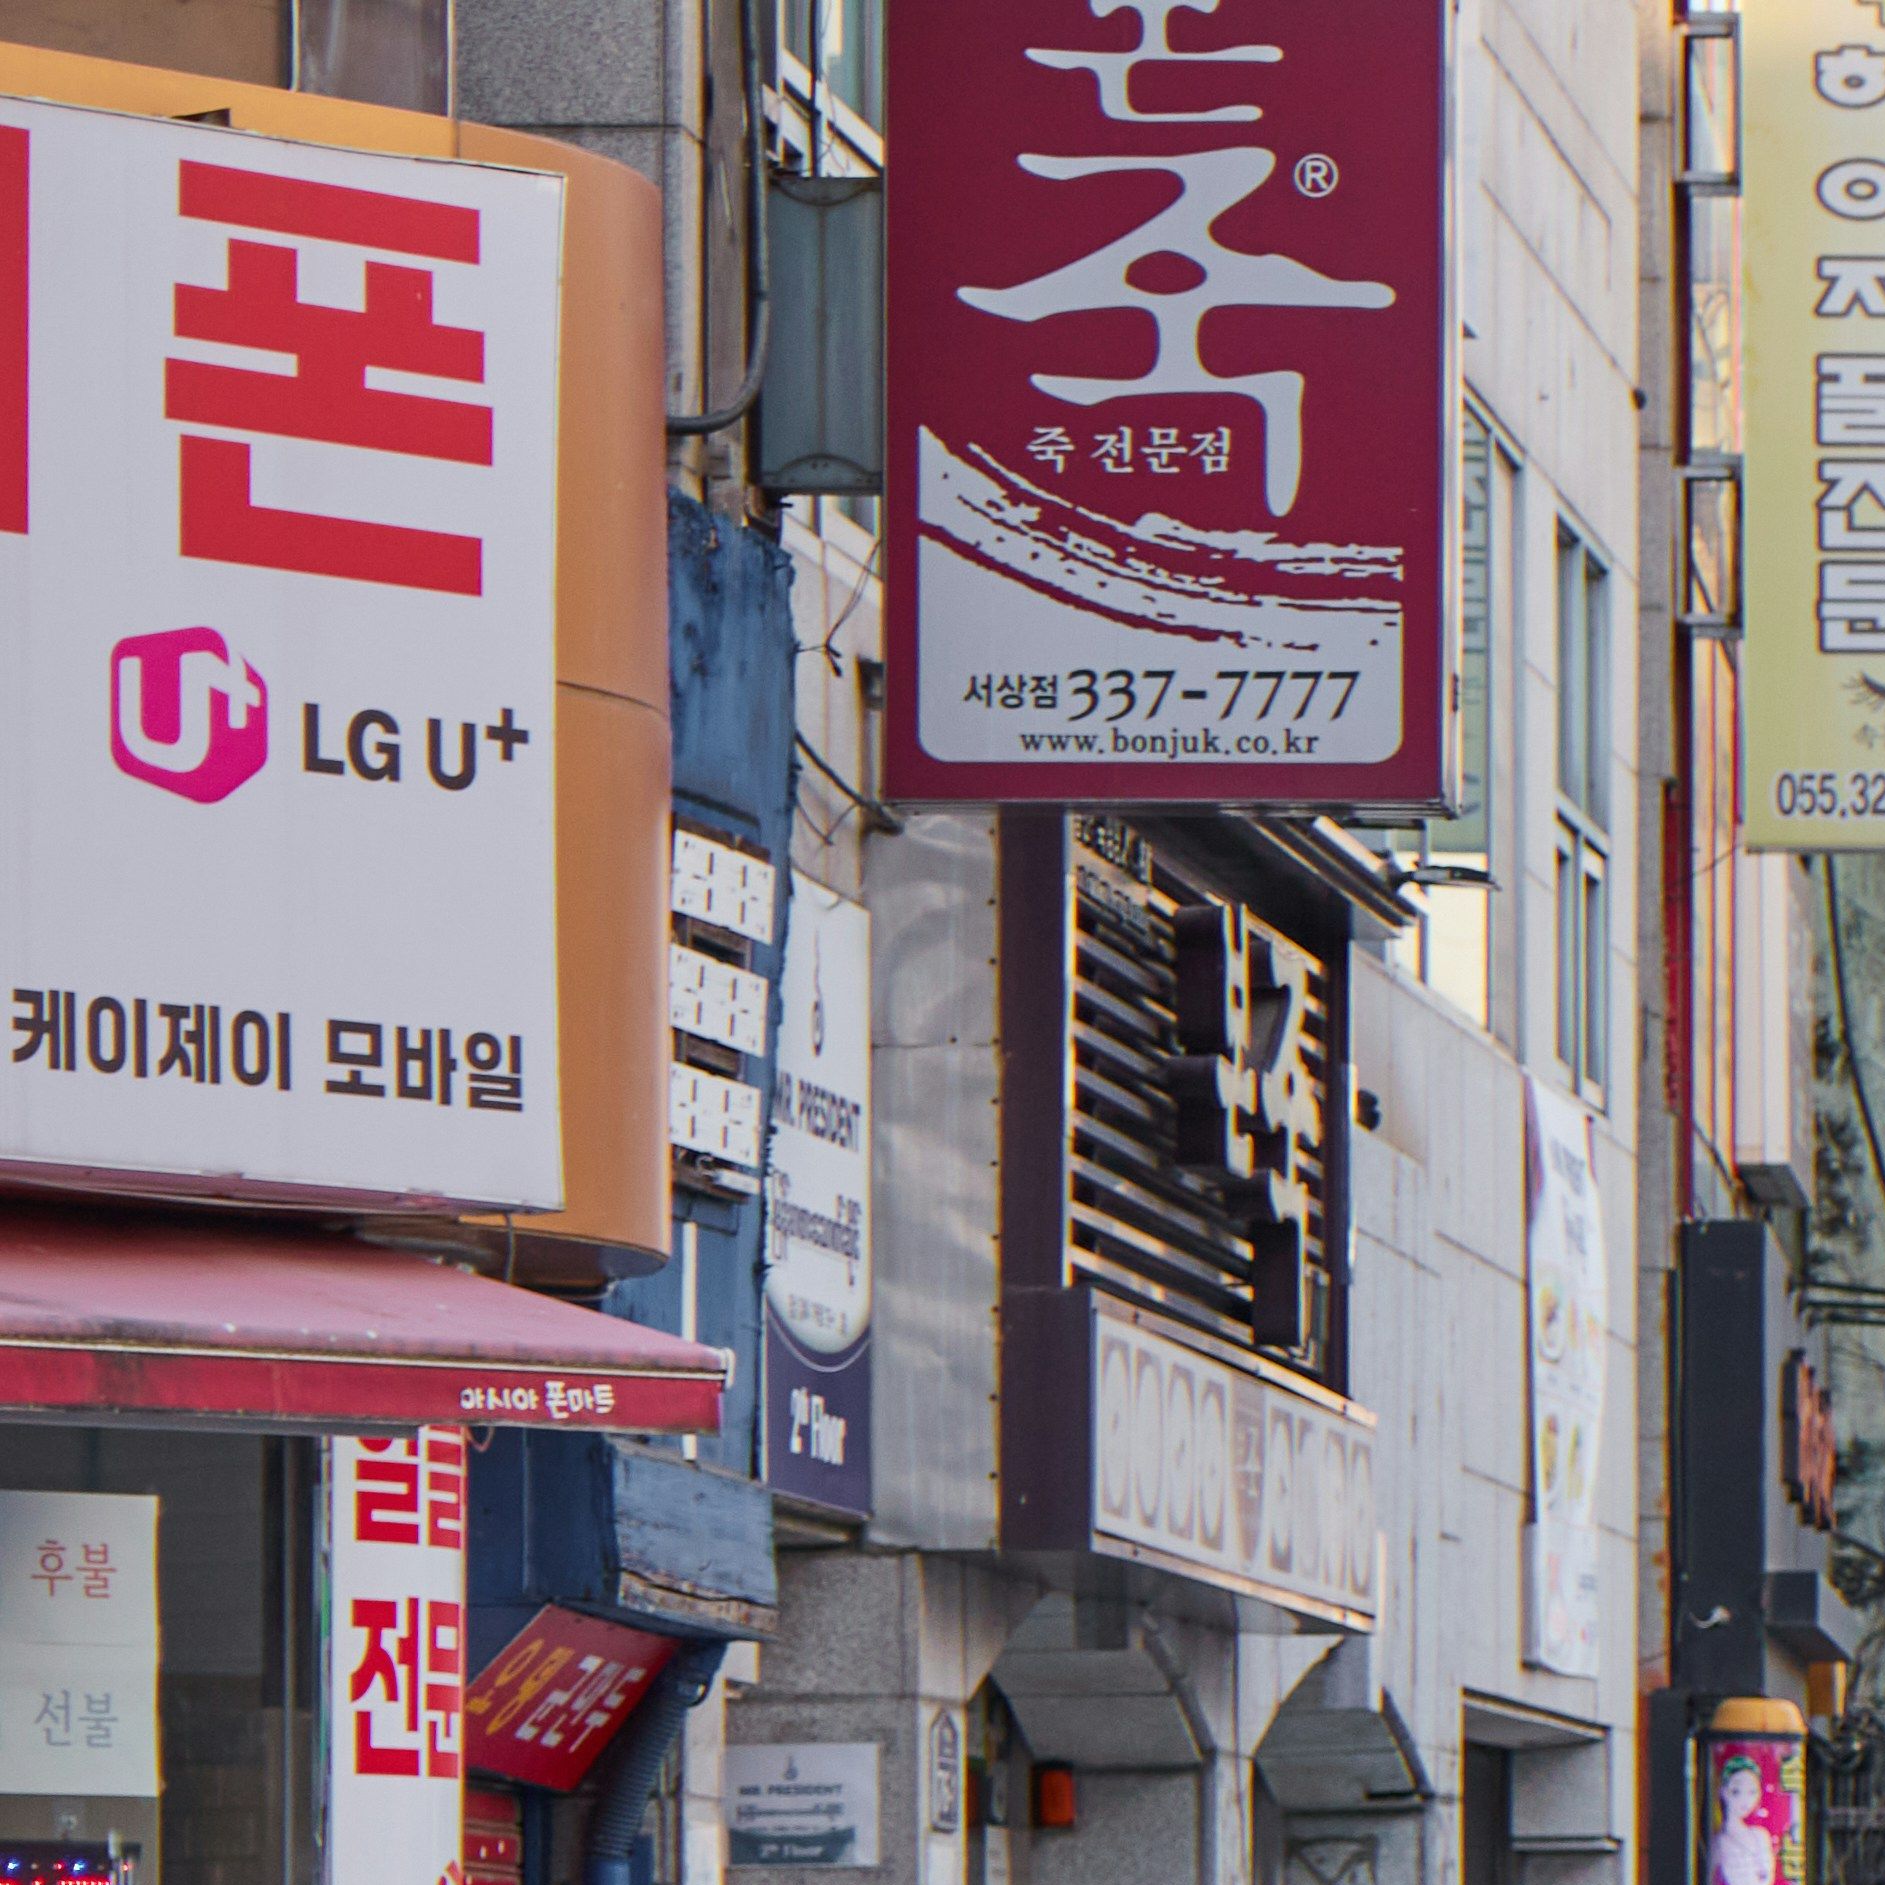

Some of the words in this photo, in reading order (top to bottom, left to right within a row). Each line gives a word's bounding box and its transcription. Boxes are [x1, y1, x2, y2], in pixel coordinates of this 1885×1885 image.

[165, 159, 493, 597] 폰
[1027, 427, 1075, 474] 죽
[1092, 427, 1232, 475] 전문점
[963, 674, 1060, 711] 서상점
[1067, 669, 1361, 723] 337-7777
[303, 703, 402, 783] LG
[426, 708, 530, 790] U+
[1019, 728, 1320, 760] www.bonjuk.co.kr
[11, 989, 293, 1092] 케이제이
[324, 1017, 525, 1114] 모바일
[460, 1388, 539, 1411] 아시아
[544, 1380, 615, 1419] 폰마트
[31, 1541, 118, 1598] 후불
[33, 1692, 119, 1749] 선불
